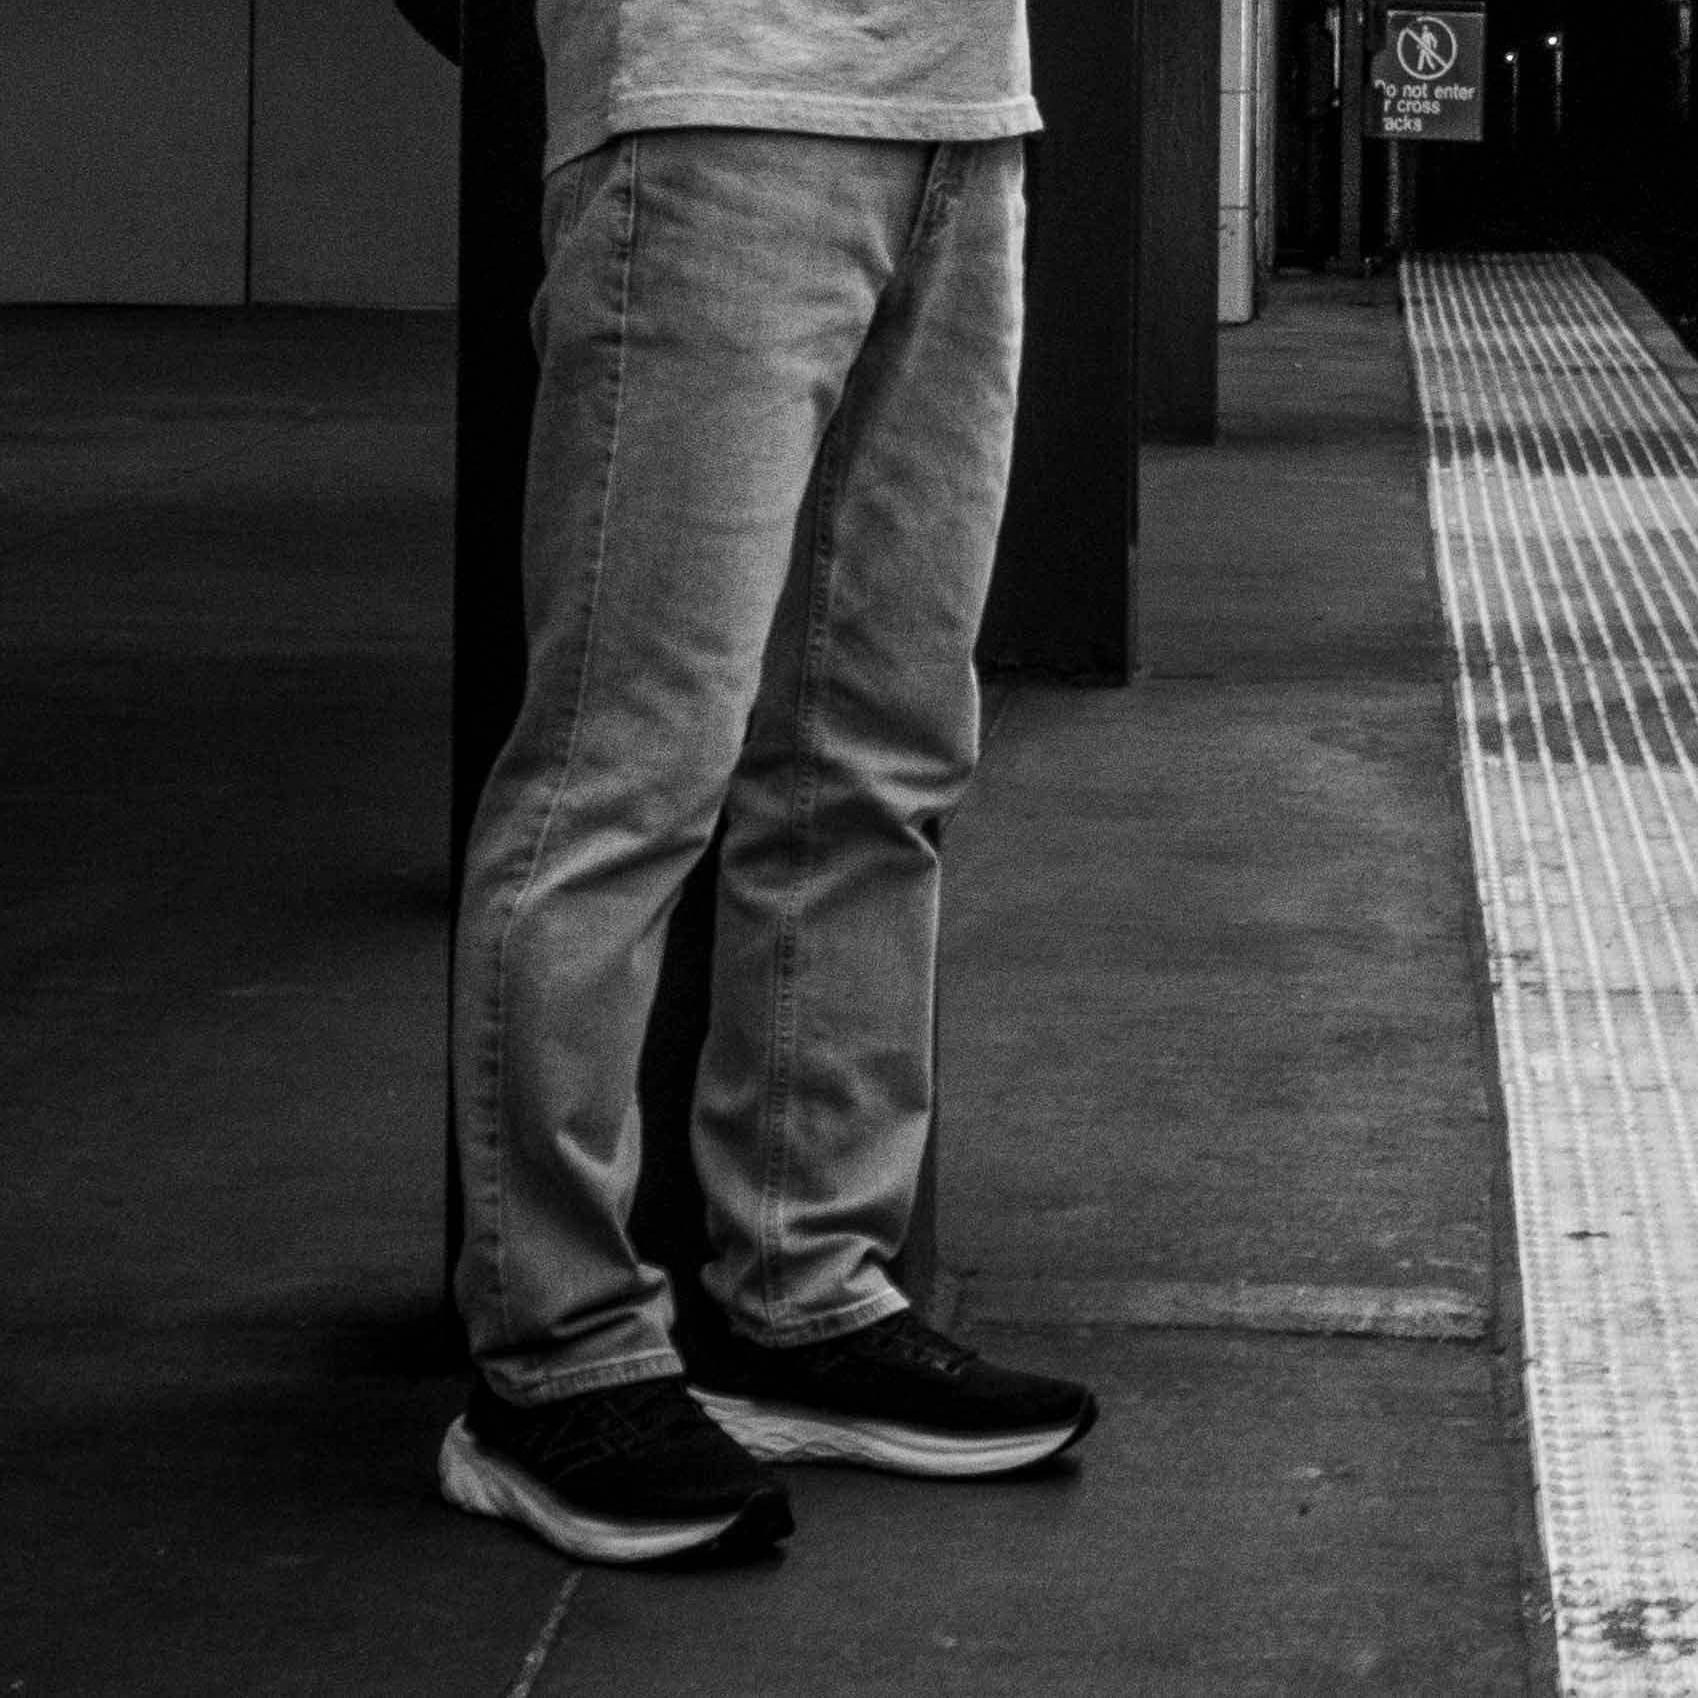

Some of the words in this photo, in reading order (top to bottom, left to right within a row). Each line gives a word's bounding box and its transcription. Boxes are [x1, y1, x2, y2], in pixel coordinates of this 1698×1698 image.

[1402, 83, 1428, 99] not
[1434, 83, 1476, 101] enter
[1396, 99, 1441, 114] cross
[1383, 114, 1423, 132] acks
